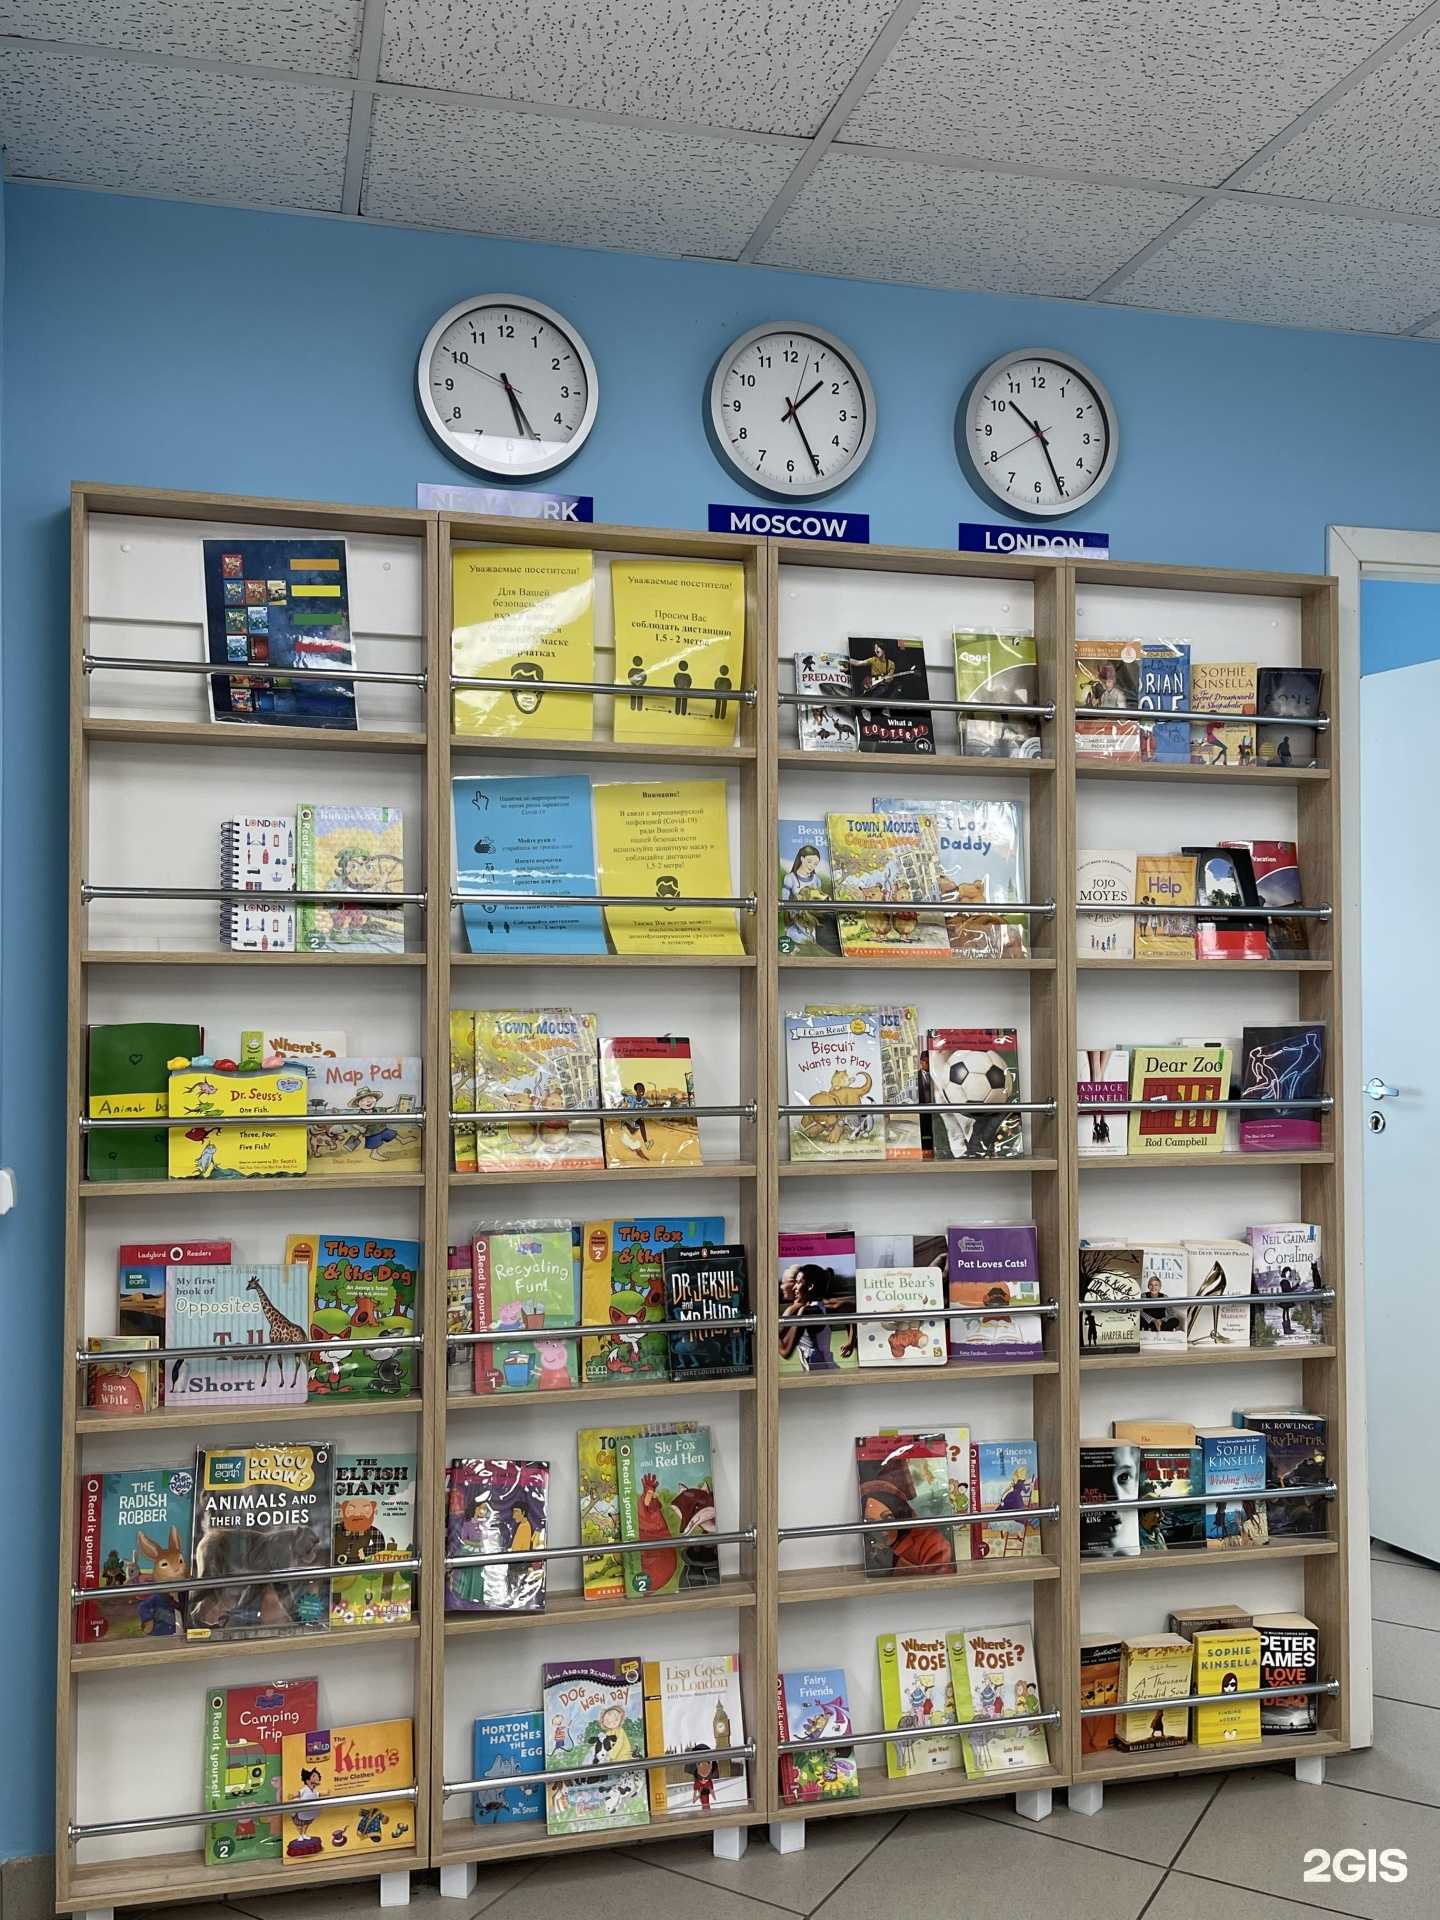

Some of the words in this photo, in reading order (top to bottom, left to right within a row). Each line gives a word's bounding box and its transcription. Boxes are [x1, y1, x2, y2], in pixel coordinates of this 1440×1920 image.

[758, 356, 772, 368] 11
[783, 351, 799, 363] 12
[814, 361, 820, 373] 1
[740, 374, 756, 387] 10
[1031, 376, 1046, 389] 12
[831, 383, 840, 394] 2
[1008, 382, 1021, 394] 11
[1059, 387, 1065, 398] 1
[733, 400, 742, 412] 9
[991, 400, 1006, 412] 10
[839, 410, 847, 422] 3
[1076, 407, 1084, 419] 2
[739, 427, 748, 440] 8
[984, 424, 993, 436] 9
[831, 435, 840, 447] 4
[1082, 434, 1090, 445] 3
[758, 450, 767, 462] 7
[990, 450, 998, 462] 8
[786, 460, 795, 472] 6
[1076, 457, 1084, 469] 4
[1008, 472, 1016, 484] 7
[1034, 481, 1042, 493] 6
[730, 512, 847, 538] MOSCOW
[985, 531, 1084, 555] LONDON
[469, 564, 521, 574] Уважаемые
[524, 566, 580, 575] посетители!
[628, 576, 678, 586] Уважаемые
[680, 580, 732, 590] посетители!
[498, 587, 516, 597] Для
[655, 610, 688, 621] Просим
[691, 613, 707, 623] Вас
[631, 621, 679, 633] соблюдать
[682, 626, 731, 637] дистанцию
[1200, 667, 1246, 677] SOPHIE
[1192, 679, 1254, 689] KINSELLA
[864, 724, 925, 740] LOTTERY!
[245, 819, 286, 828] LONDON
[847, 820, 880, 833] TOWN
[883, 820, 920, 834] MOUSE
[940, 837, 991, 856] Daddy
[1093, 880, 1115, 889] JOJO
[1149, 877, 1182, 898] Help
[1080, 891, 1128, 901] MOYES
[244, 904, 286, 912] LONDON
[269, 1037, 322, 1053] Where's
[811, 1042, 855, 1055] Biscuit
[799, 1056, 832, 1073] Wants
[835, 1056, 847, 1065] to
[850, 1056, 871, 1070] Play
[1145, 1057, 1187, 1073] Dear
[1193, 1056, 1223, 1072] Zoo
[326, 1067, 363, 1086] Map
[370, 1064, 402, 1081] Pad
[231, 1090, 246, 1101] Dr.
[249, 1088, 282, 1102] Seuss's
[255, 1143, 271, 1151] Fish!
[1145, 1138, 1160, 1147] Rod
[1165, 1136, 1207, 1148] Campbell
[618, 1227, 650, 1242] The
[655, 1225, 683, 1242] Fox
[138, 1251, 166, 1260] Ladybird
[324, 1240, 359, 1258] The
[365, 1240, 396, 1259] Fox
[1264, 1246, 1314, 1264] Coraline
[958, 1260, 975, 1268] Pat
[977, 1259, 1002, 1268] Loves
[1005, 1259, 1027, 1268] Cats!
[324, 1264, 340, 1280] &
[343, 1263, 372, 1281] the
[377, 1264, 412, 1286] Dog
[495, 1260, 568, 1281] Recycling
[176, 1278, 190, 1287] My
[194, 1277, 216, 1285] first
[515, 1278, 549, 1295] Fun!
[672, 1272, 691, 1305] DR
[693, 1271, 739, 1302] JEKYLL
[863, 1278, 894, 1290] Little
[900, 1275, 935, 1289] Bear's
[176, 1287, 200, 1296] book
[205, 1287, 215, 1295] of
[875, 1289, 922, 1302] Colours
[176, 1299, 260, 1317] Opposites
[682, 1300, 693, 1310] and
[103, 1383, 126, 1392] Snow
[189, 1377, 255, 1393] Short
[1275, 1422, 1314, 1430] ROWLING
[655, 1441, 672, 1455] Sly
[676, 1440, 695, 1451] Fox
[996, 1447, 1033, 1457] Princess
[1216, 1445, 1257, 1456] SOPHIE
[250, 1457, 268, 1468] DO
[273, 1454, 307, 1470] YOU
[640, 1459, 653, 1468] and
[655, 1456, 678, 1468] Red
[682, 1453, 705, 1466] Hen
[1011, 1457, 1028, 1465] Pea
[1209, 1456, 1264, 1468] KINSELLA
[250, 1470, 310, 1489] KNOW?
[336, 1467, 408, 1481] ELFISH
[131, 1482, 154, 1493] THE
[335, 1482, 399, 1496] GIANT
[87, 1495, 97, 1520] Read
[119, 1493, 167, 1509] RADISH
[206, 1493, 287, 1511] ANIMALS
[292, 1495, 317, 1505] AND
[119, 1509, 167, 1526] ROBBER
[211, 1516, 241, 1526] THEIR
[246, 1509, 309, 1527] BODIES
[85, 1534, 96, 1579] yourself
[901, 1637, 945, 1652] Where's
[969, 1637, 1012, 1651] Where's
[1260, 1636, 1316, 1651] PETER
[1207, 1646, 1251, 1658] SOPHIE
[906, 1652, 946, 1670] ROSE
[1201, 1658, 1257, 1670] KINSELLA
[1261, 1652, 1316, 1668] AMES
[562, 1669, 589, 1677] ABOARD
[590, 1668, 617, 1681] READING
[666, 1667, 690, 1681] Lisa
[694, 1663, 726, 1678] Goes
[1265, 1668, 1306, 1681] LOVE
[667, 1683, 678, 1693] to
[681, 1677, 728, 1692] London
[803, 1675, 826, 1687] Fairy
[1146, 1672, 1188, 1689] Thousand
[559, 1687, 585, 1707] DOG
[800, 1687, 833, 1697] Friends
[1130, 1688, 1166, 1702] Splendid
[1170, 1688, 1188, 1697] Suns
[240, 1711, 299, 1727] Camping
[257, 1727, 282, 1743] Trip
[482, 1722, 528, 1735] HORTON
[490, 1731, 541, 1745] HATCHES
[510, 1742, 526, 1750] THE
[521, 1747, 543, 1758] EGG
[1129, 1741, 1155, 1751] KHALED
[334, 1740, 399, 1774] King's
[350, 1772, 374, 1780] Clothes
[219, 1846, 228, 1858] 2
